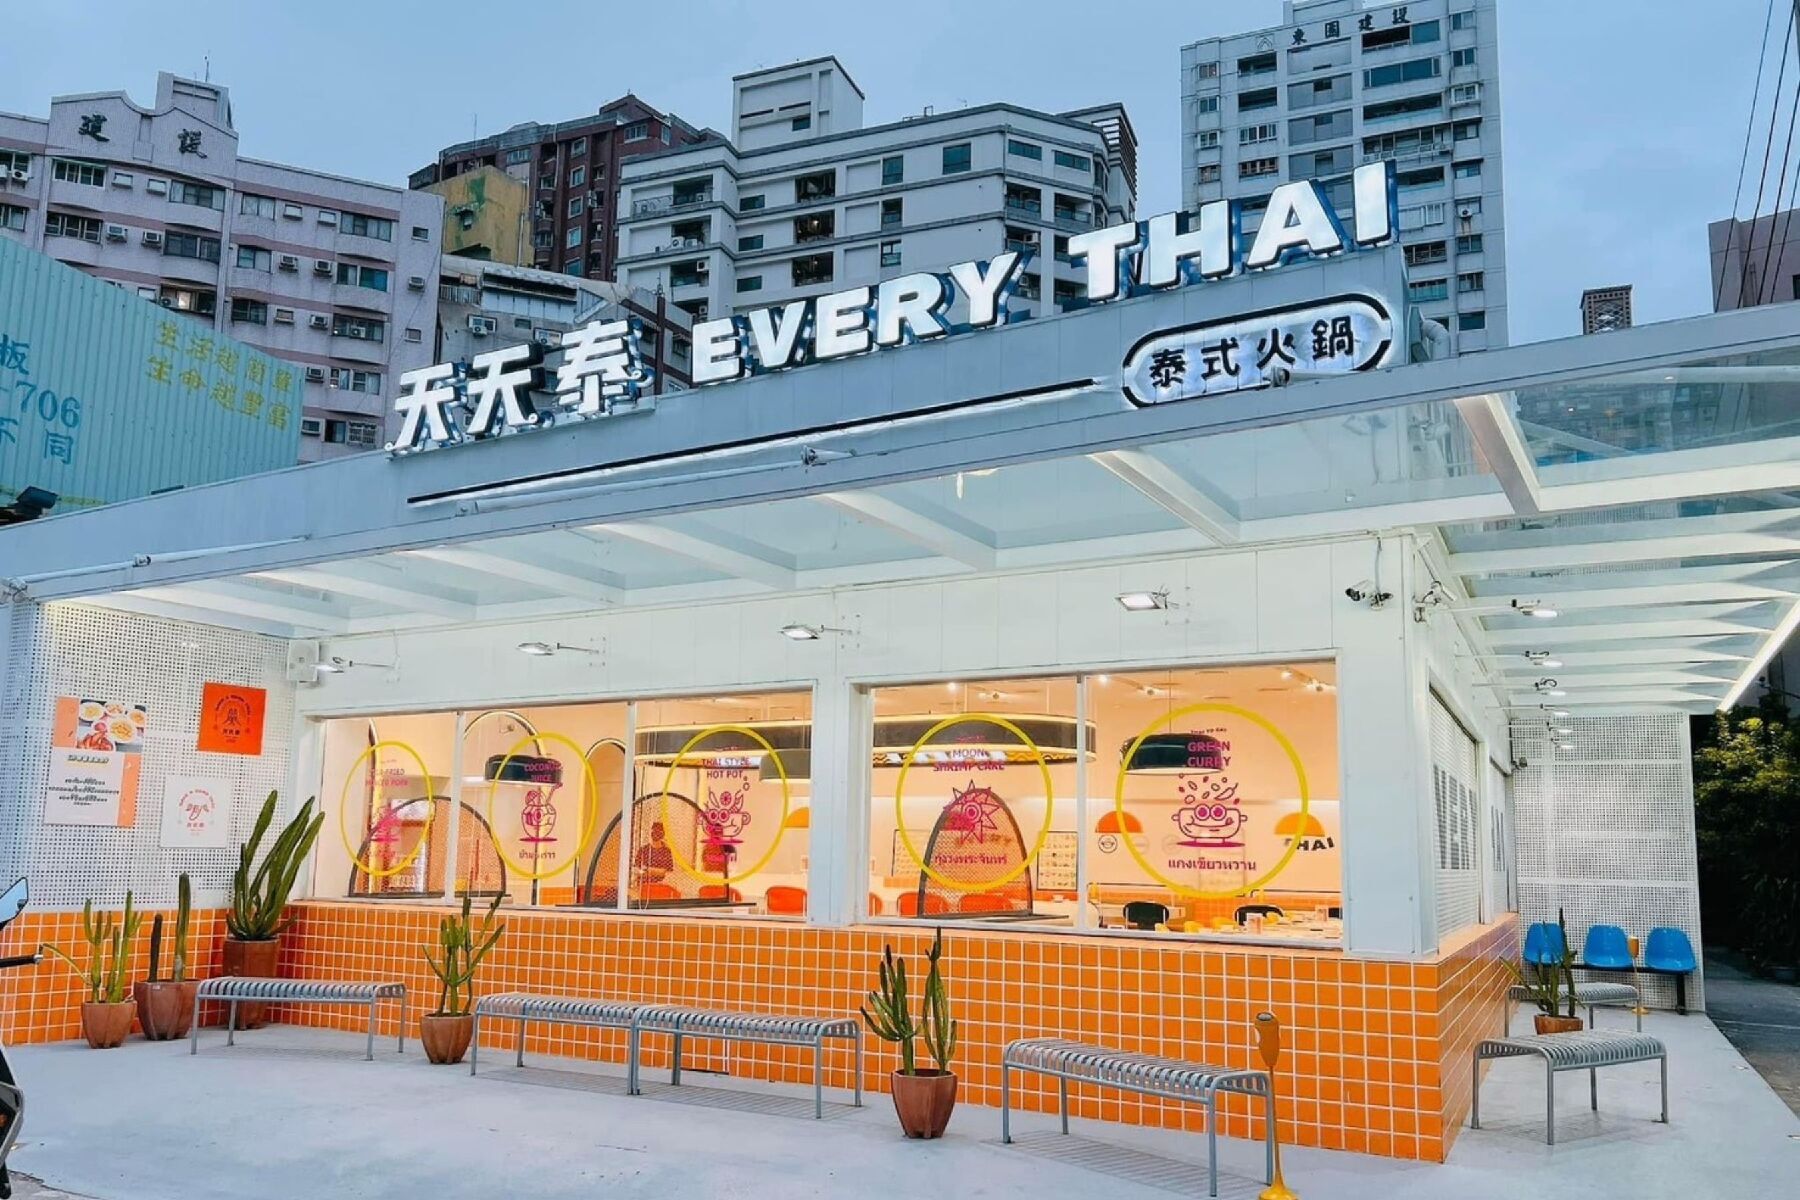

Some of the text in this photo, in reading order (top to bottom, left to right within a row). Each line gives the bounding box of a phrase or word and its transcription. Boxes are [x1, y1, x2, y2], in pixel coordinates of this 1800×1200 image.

[692, 160, 1394, 385] EVERY THAI
[1149, 315, 1355, 388] 泰式火鍋
[1187, 740, 1231, 752] GREEN
[952, 748, 986, 758] MOON
[1187, 756, 1231, 767] CURRY
[706, 770, 743, 779] HOT POT
[1168, 856, 1257, 871] แกงเขียวหวาน
